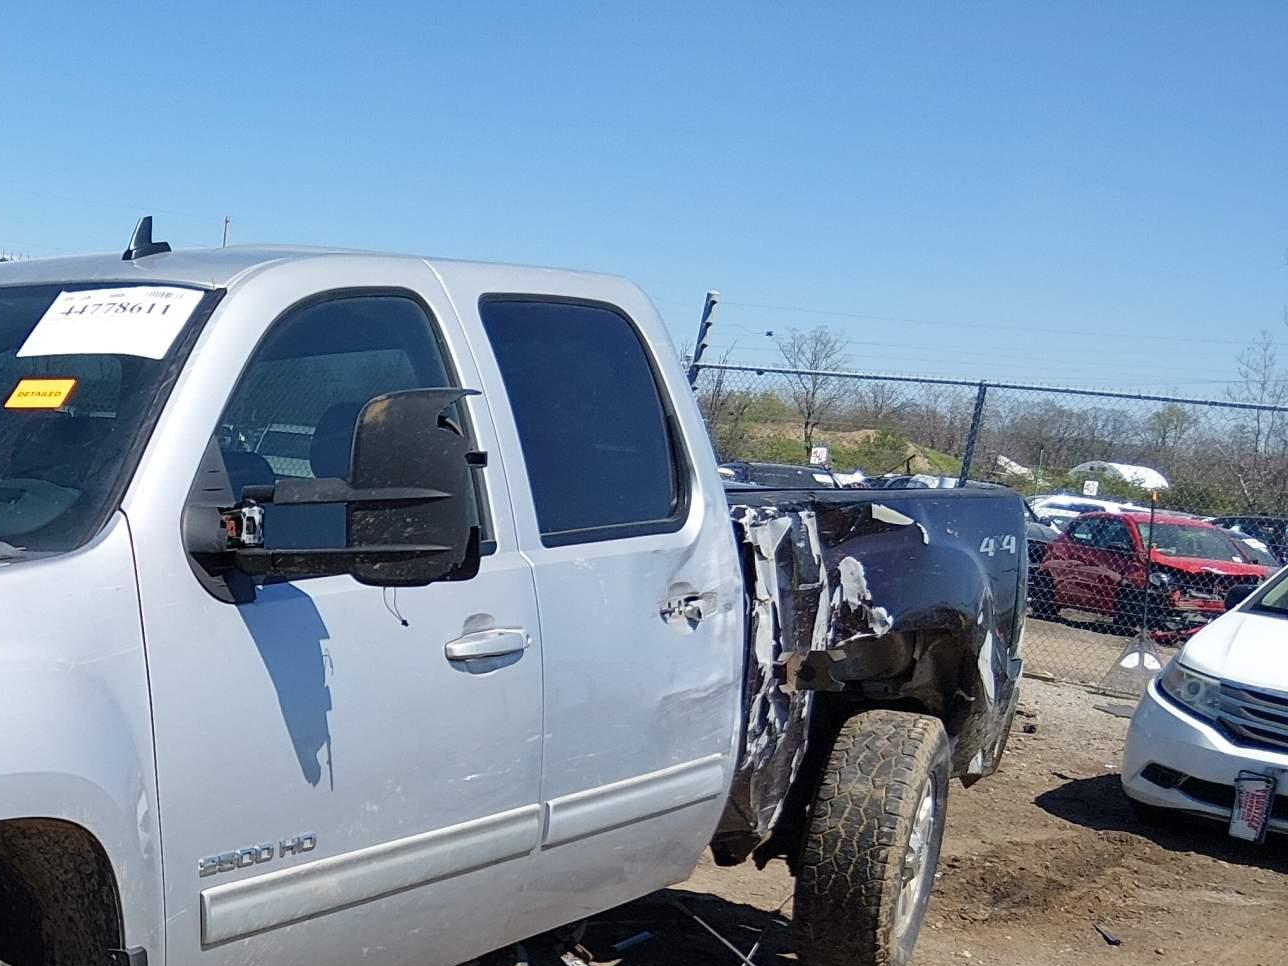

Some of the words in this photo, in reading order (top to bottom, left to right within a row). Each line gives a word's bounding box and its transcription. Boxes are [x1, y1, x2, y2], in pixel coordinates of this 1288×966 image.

[60, 301, 172, 316] 44778611
[16, 390, 62, 399] DETAILED
[198, 842, 274, 878] 2500
[279, 832, 317, 858] HD
